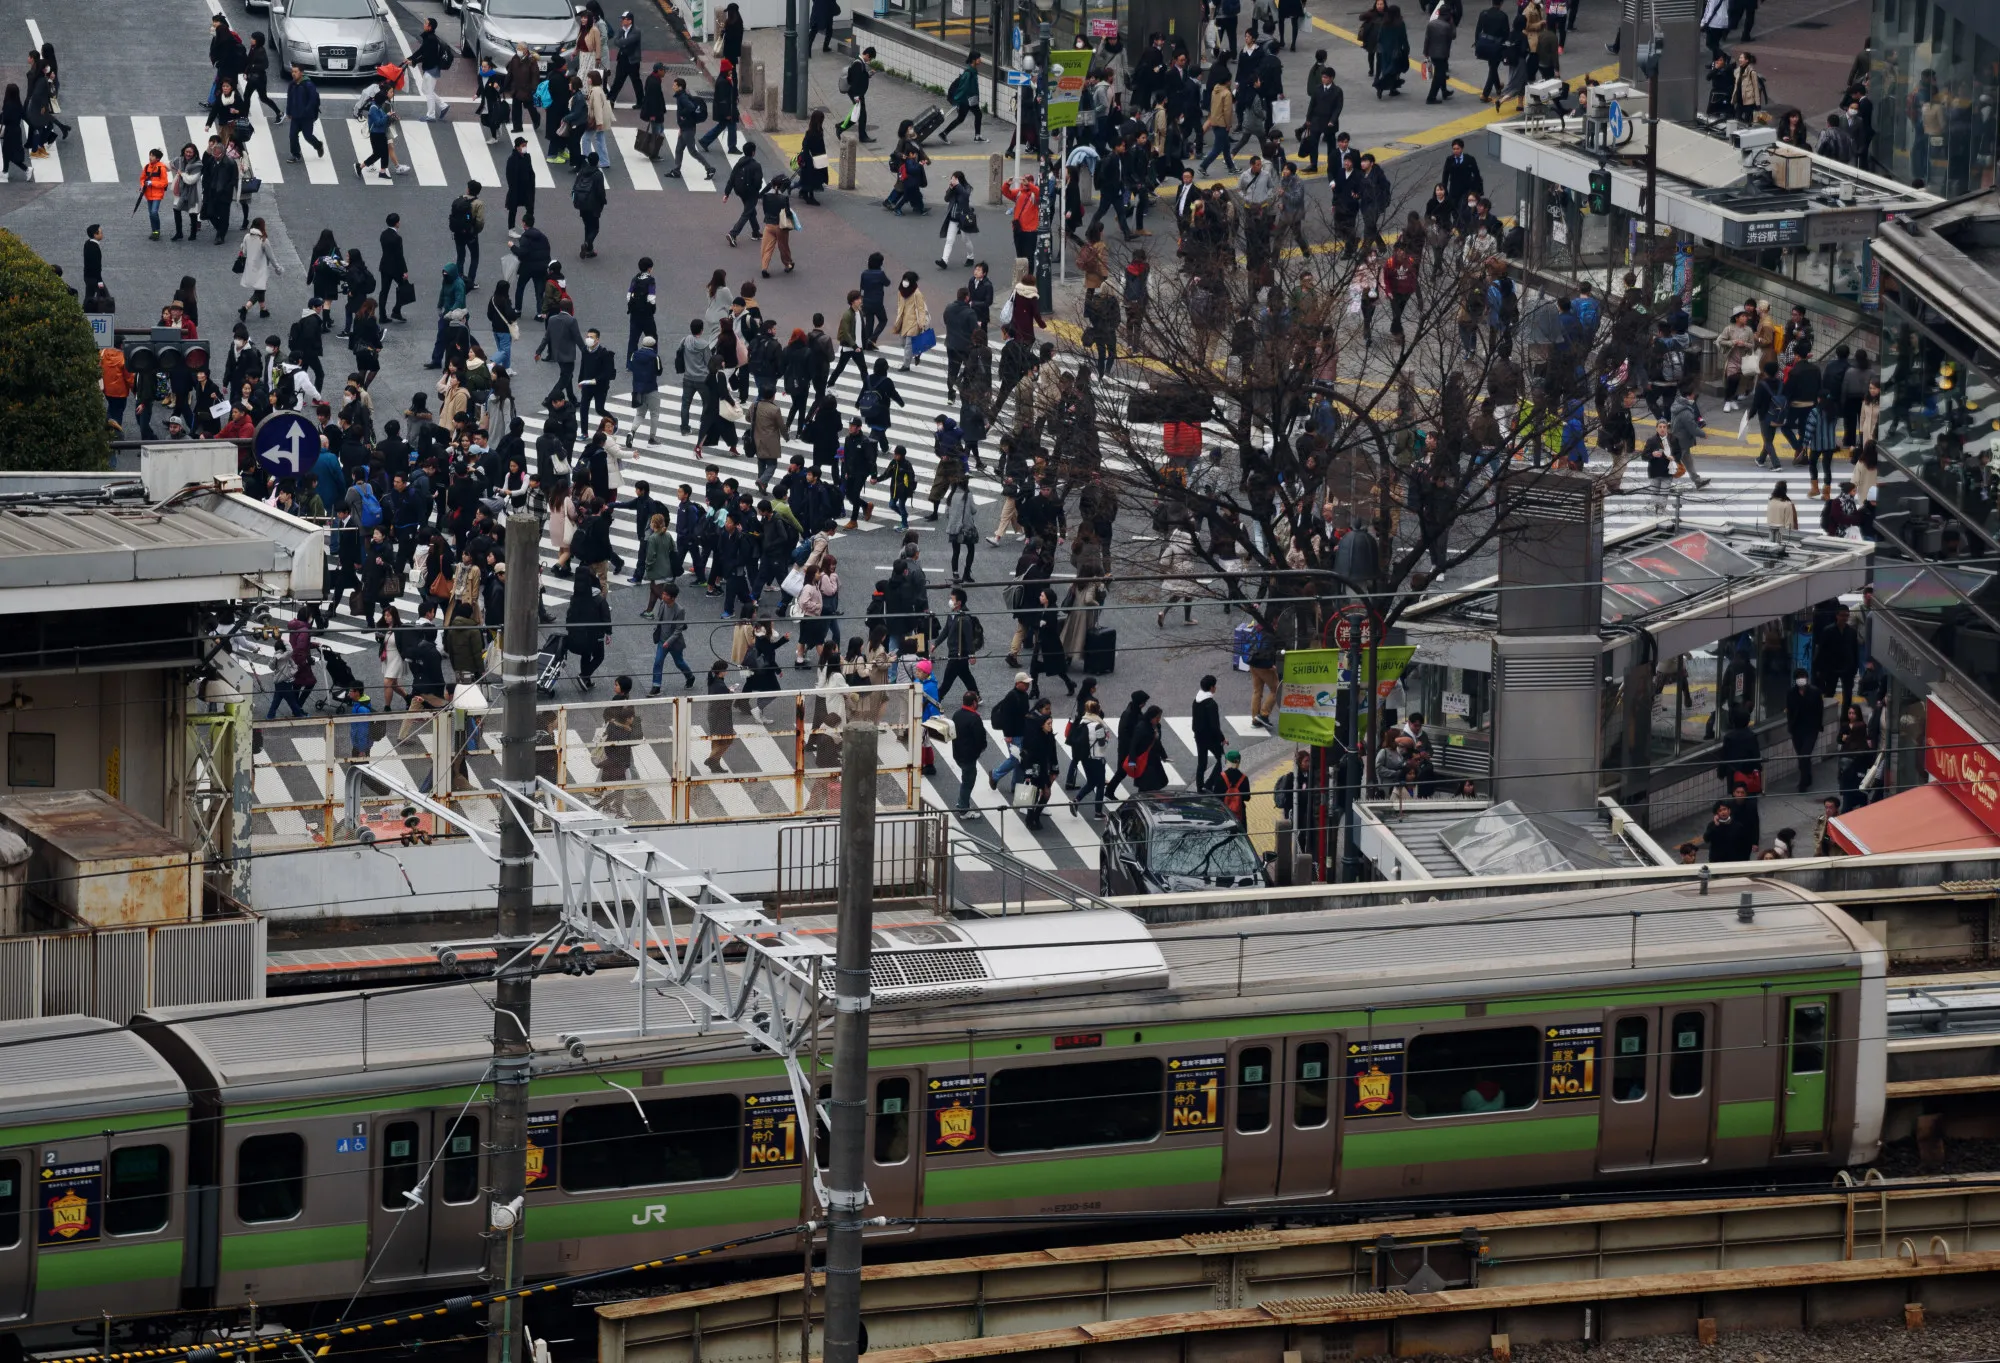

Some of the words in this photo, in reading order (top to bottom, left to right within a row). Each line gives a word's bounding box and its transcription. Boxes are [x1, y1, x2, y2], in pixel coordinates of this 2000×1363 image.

[1746, 230, 1778, 244] 渋谷駅
[1292, 665, 1329, 675] SHIBUYA
[1376, 663, 1405, 671] HIBUYA
[1552, 1062, 1574, 1074] 仲介
[1363, 1083, 1386, 1098] No.1
[1174, 1093, 1196, 1105] 仲介
[356, 1123, 363, 1134] 1
[944, 1118, 967, 1134] No.1
[752, 1130, 774, 1143] 仲介
[46, 1152, 56, 1164] 2
[57, 1208, 82, 1224] No.1
[631, 1204, 667, 1226] JR
